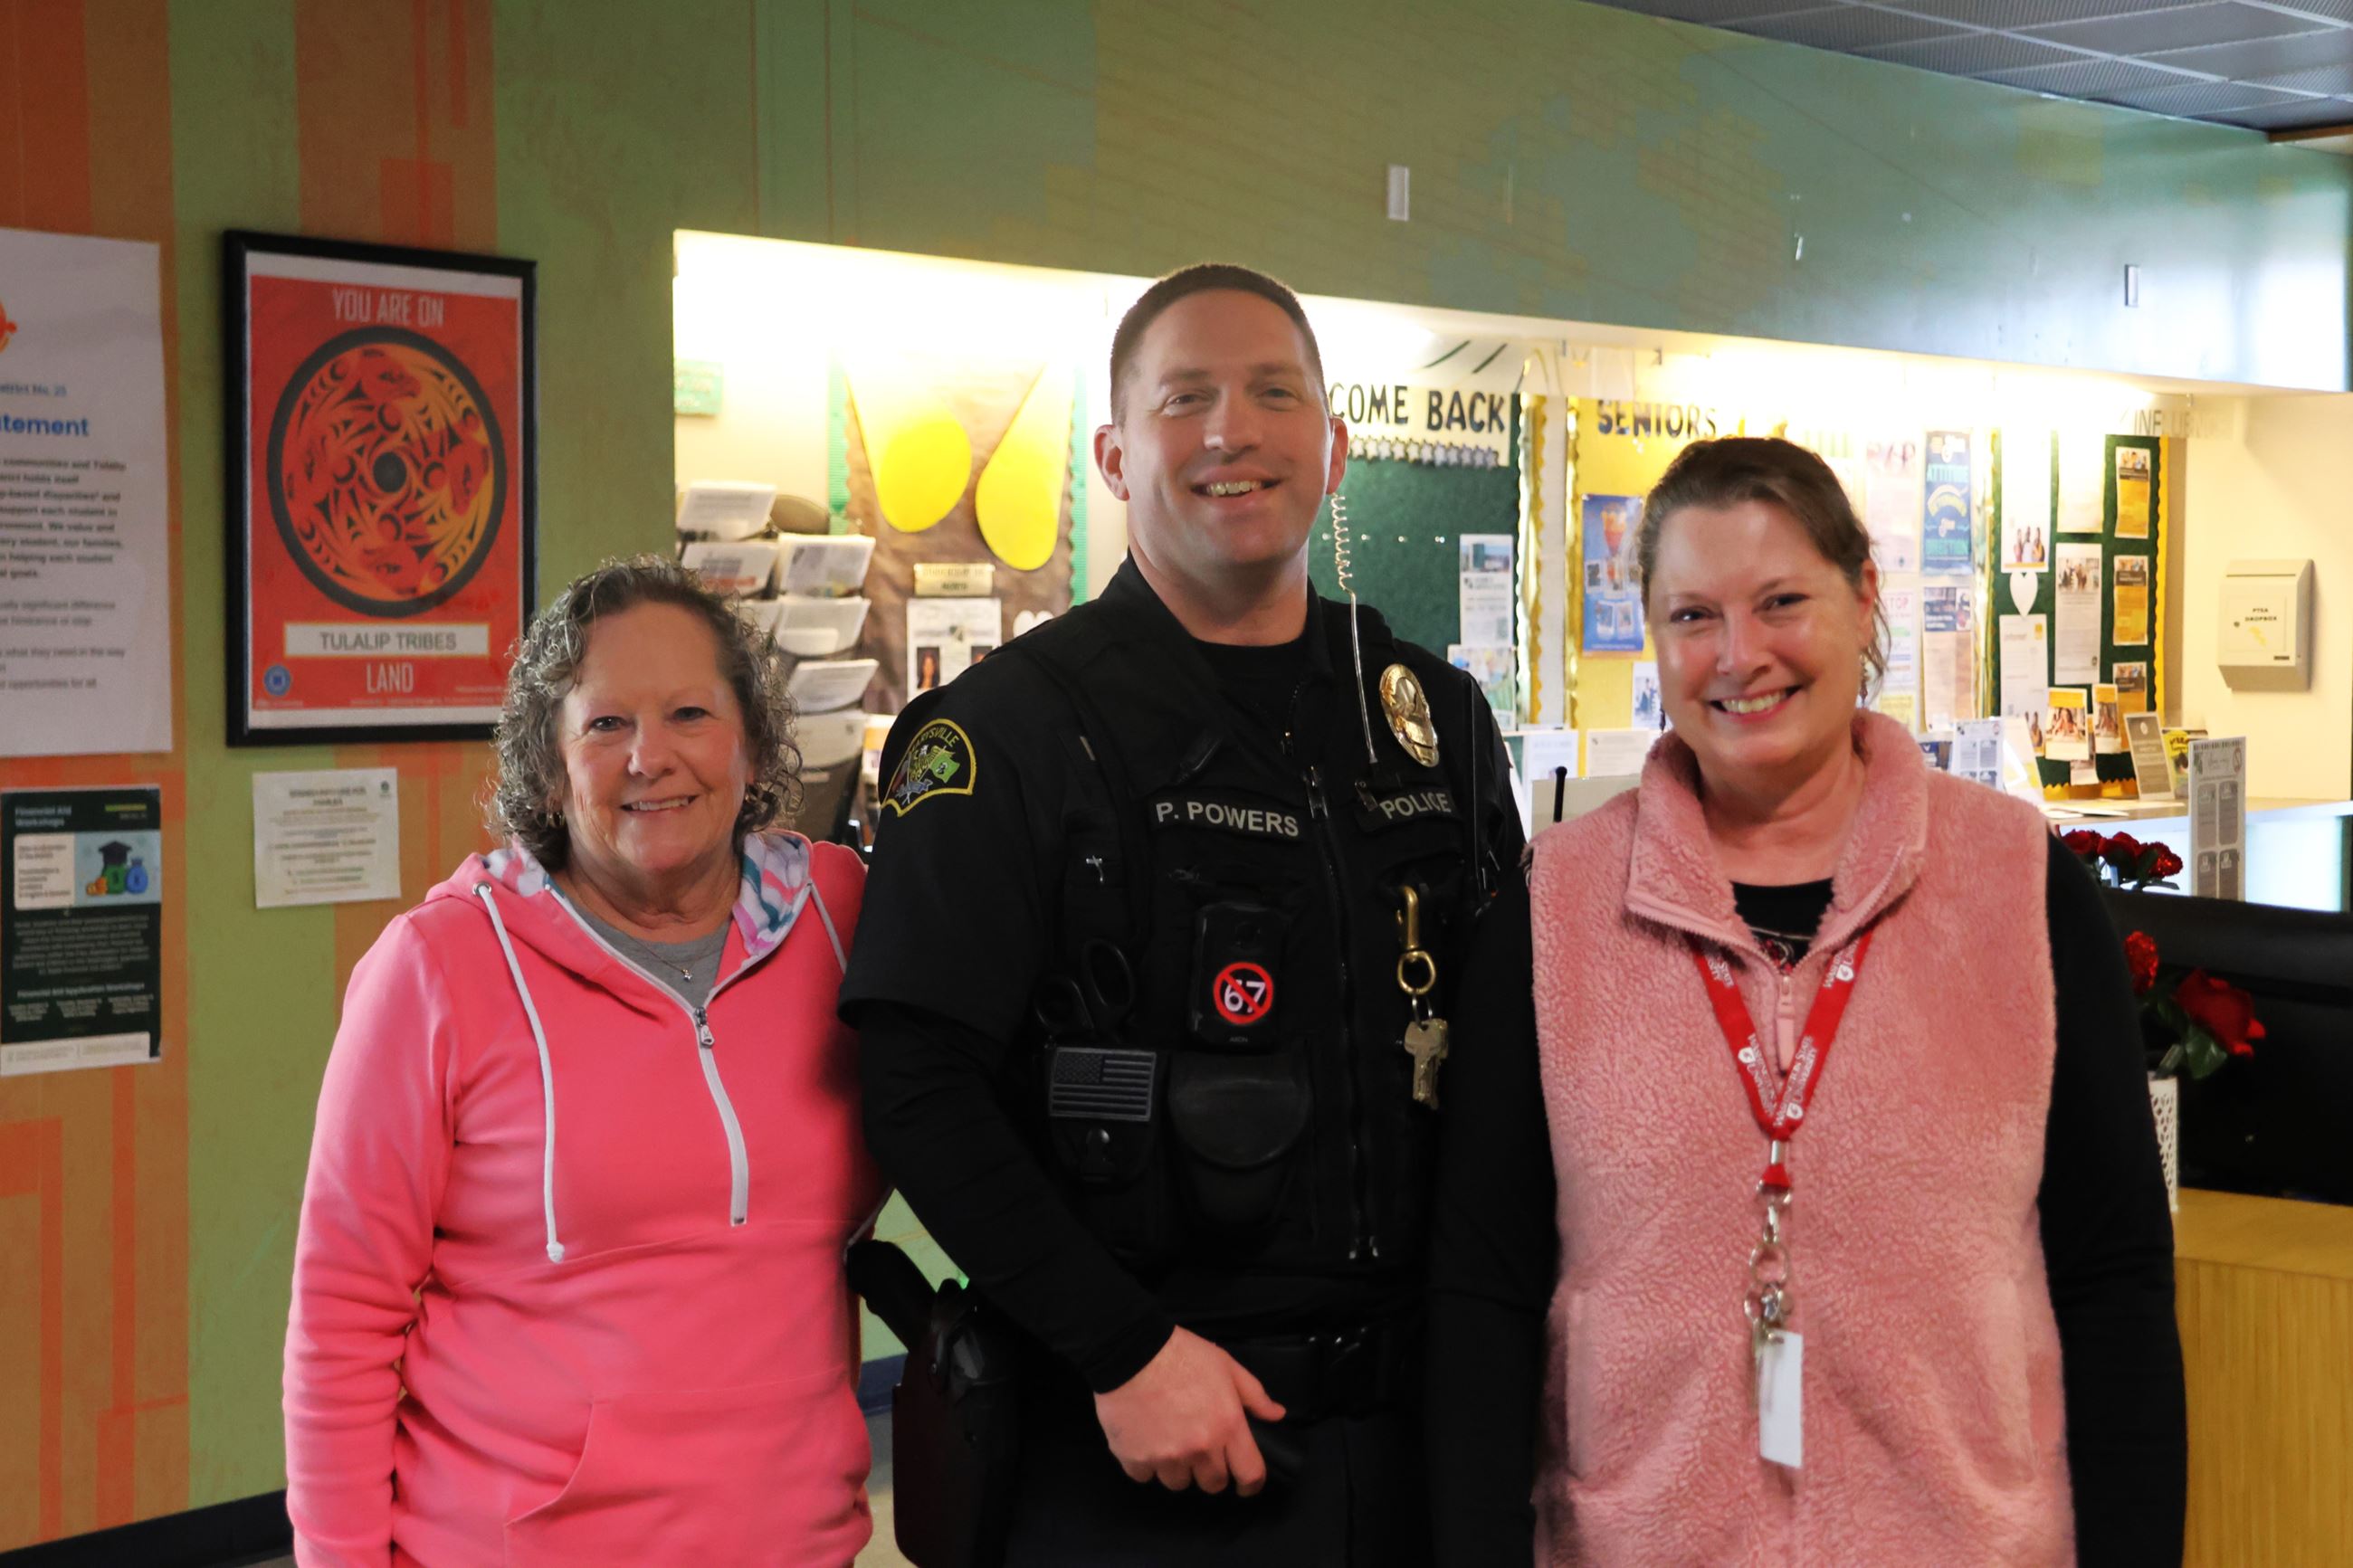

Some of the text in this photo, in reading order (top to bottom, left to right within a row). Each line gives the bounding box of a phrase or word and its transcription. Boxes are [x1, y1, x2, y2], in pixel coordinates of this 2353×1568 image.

[331, 288, 444, 328] YOU ARE ON
[1329, 382, 1505, 433] COME BACK
[1597, 399, 1717, 439] SENIORS
[0, 413, 90, 436] tement
[319, 632, 457, 651] TULALIP TRIBES
[366, 662, 414, 695] LAND
[1156, 801, 1299, 837] P. POWERS
[1379, 793, 1452, 820] POLICE
[1224, 980, 1266, 1012] 67
